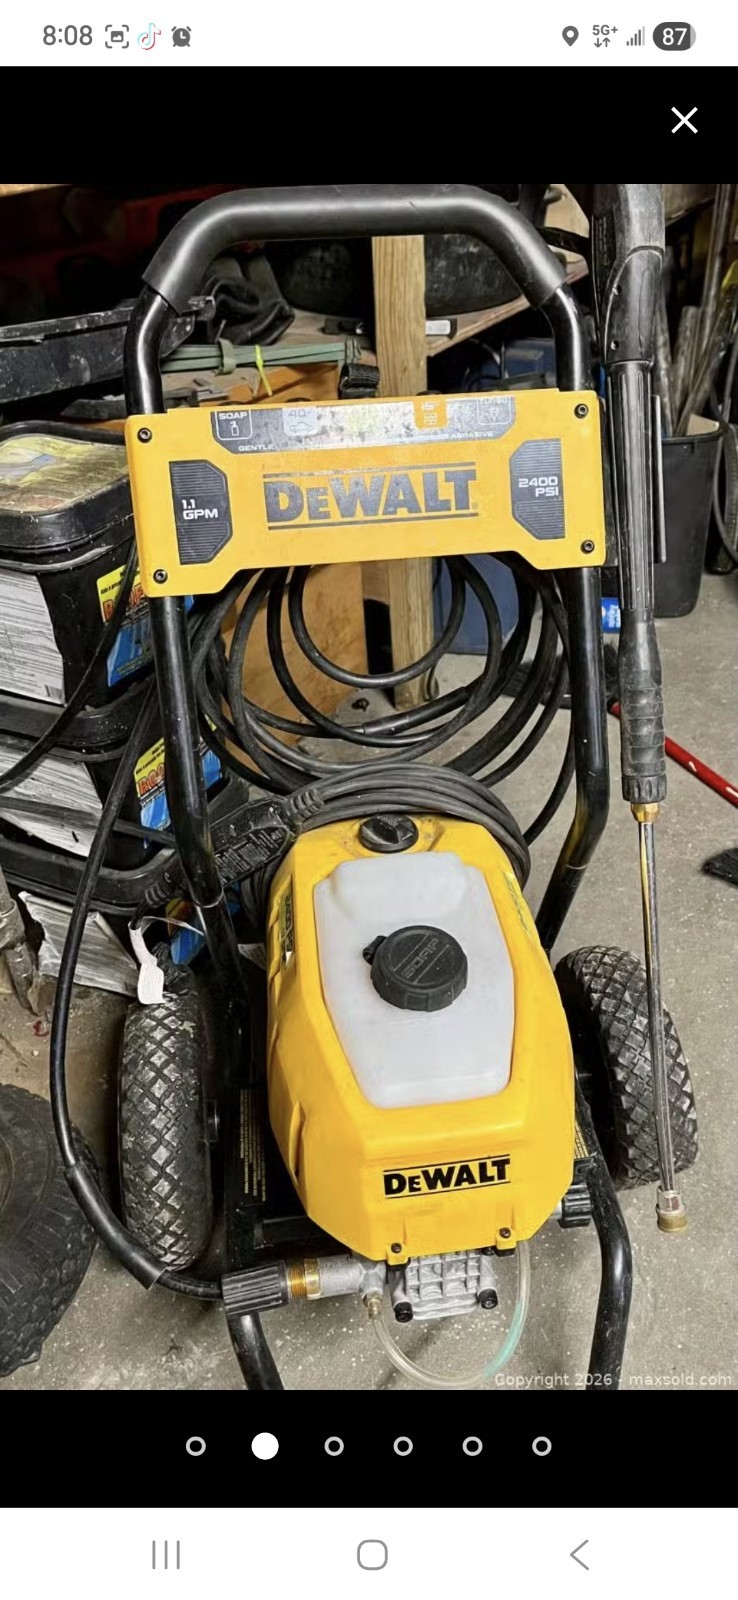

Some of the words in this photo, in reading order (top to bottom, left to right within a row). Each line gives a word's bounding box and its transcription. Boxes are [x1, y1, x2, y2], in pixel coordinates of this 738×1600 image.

[218, 411, 248, 420] SOAP
[238, 444, 275, 452] GENTLE
[518, 476, 559, 488] 2400
[535, 486, 559, 497] PSI
[181, 500, 197, 510] 1.1
[183, 508, 219, 520] GPM
[401, 937, 439, 980] SOAP
